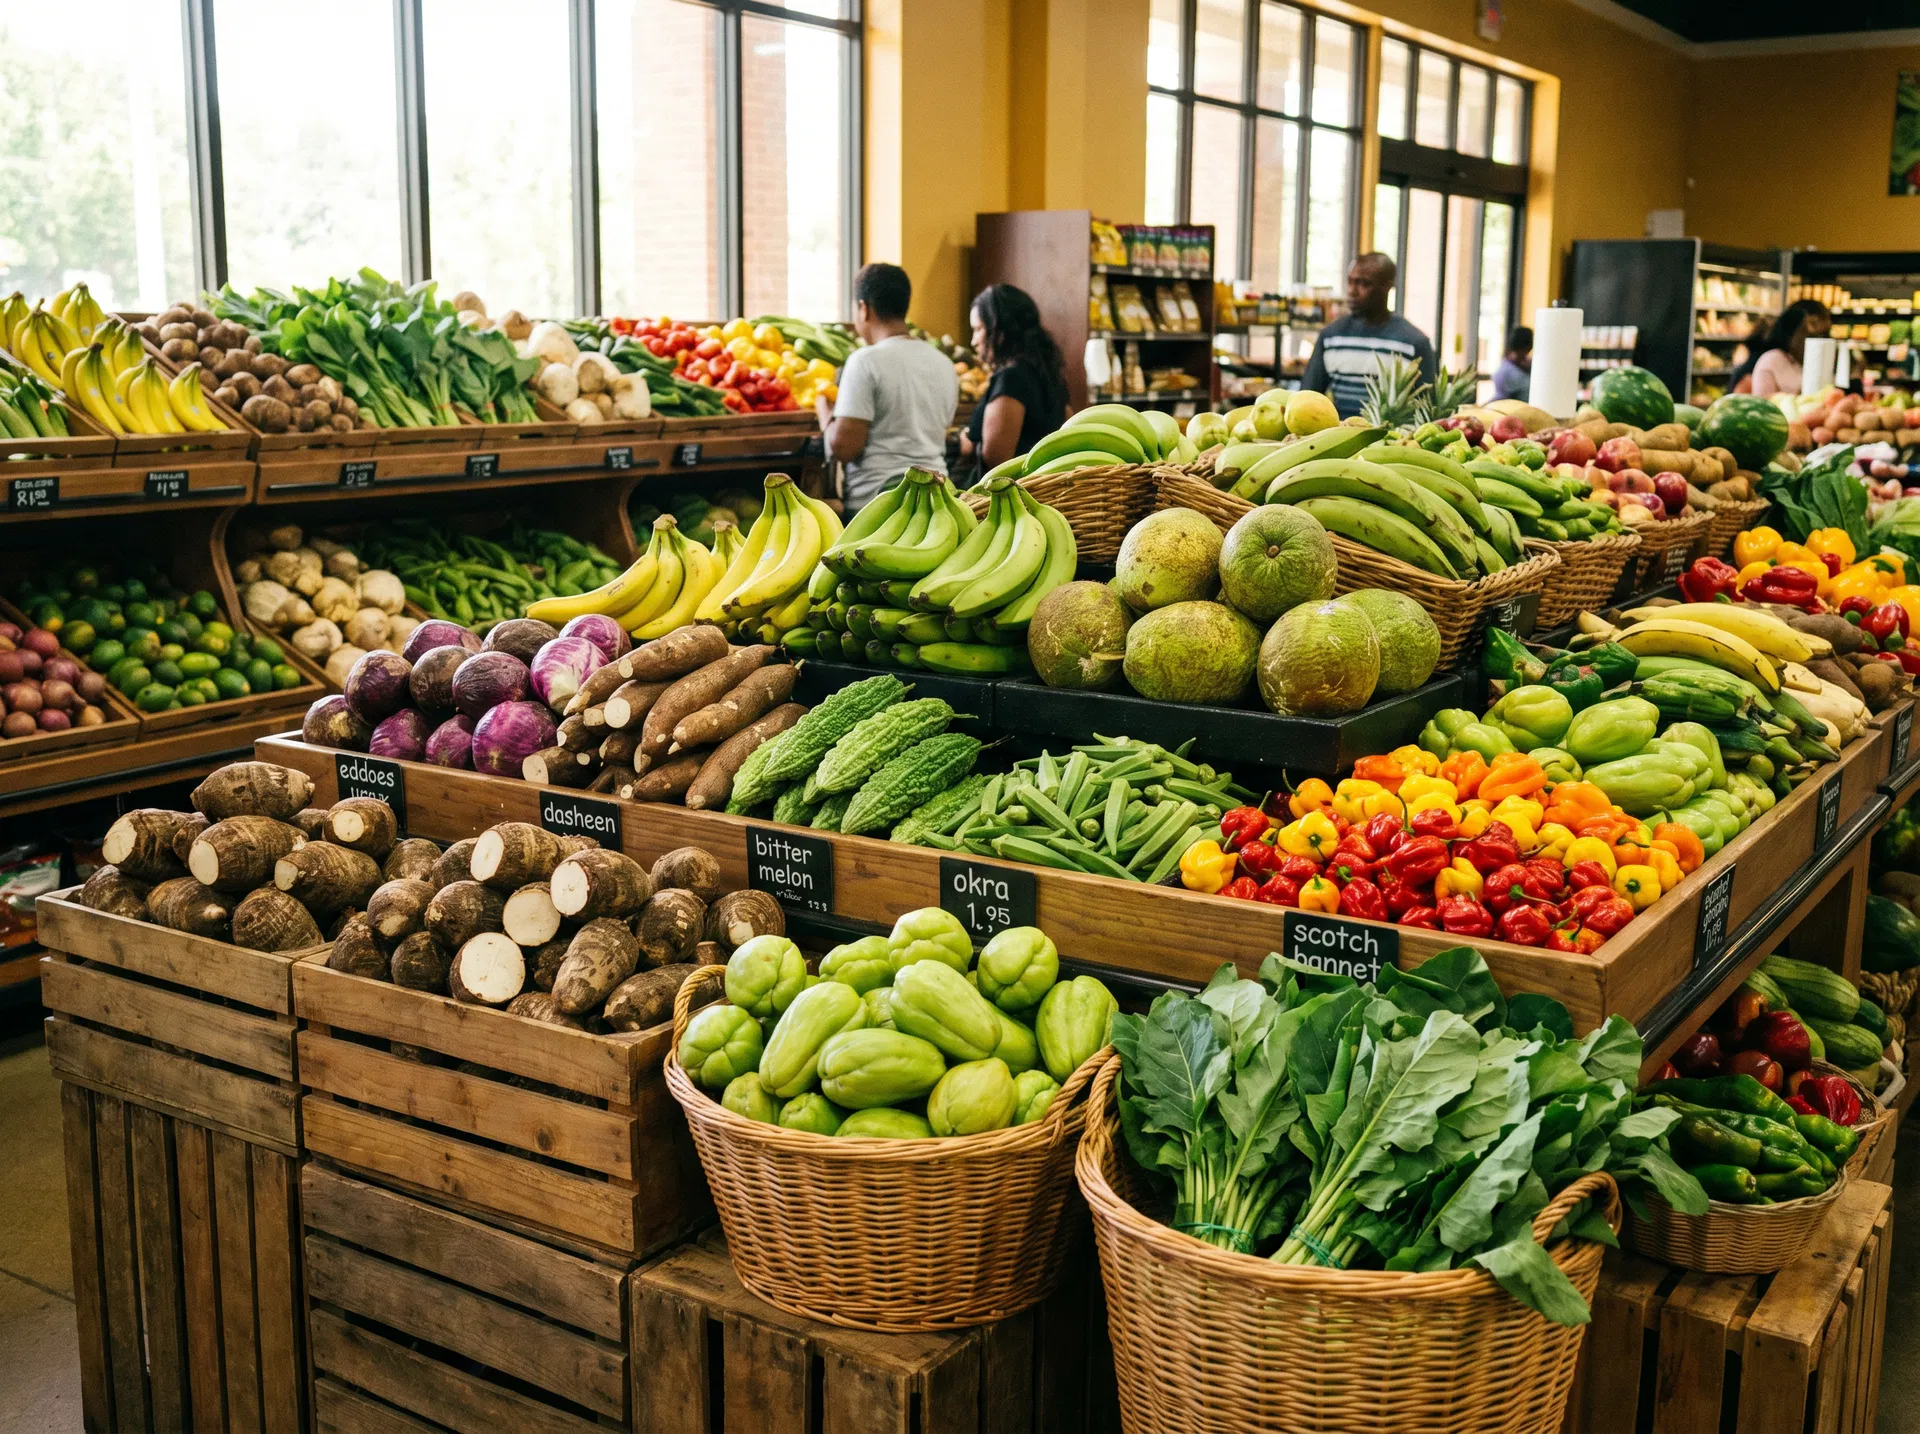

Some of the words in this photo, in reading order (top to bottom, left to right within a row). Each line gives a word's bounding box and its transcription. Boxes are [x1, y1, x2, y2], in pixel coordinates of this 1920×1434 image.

[340, 759, 395, 787] eddoes
[544, 801, 616, 833] dasheen
[755, 834, 812, 865] bitter
[759, 864, 813, 890] melon
[953, 867, 1010, 901] okra
[1293, 924, 1379, 956] scotch
